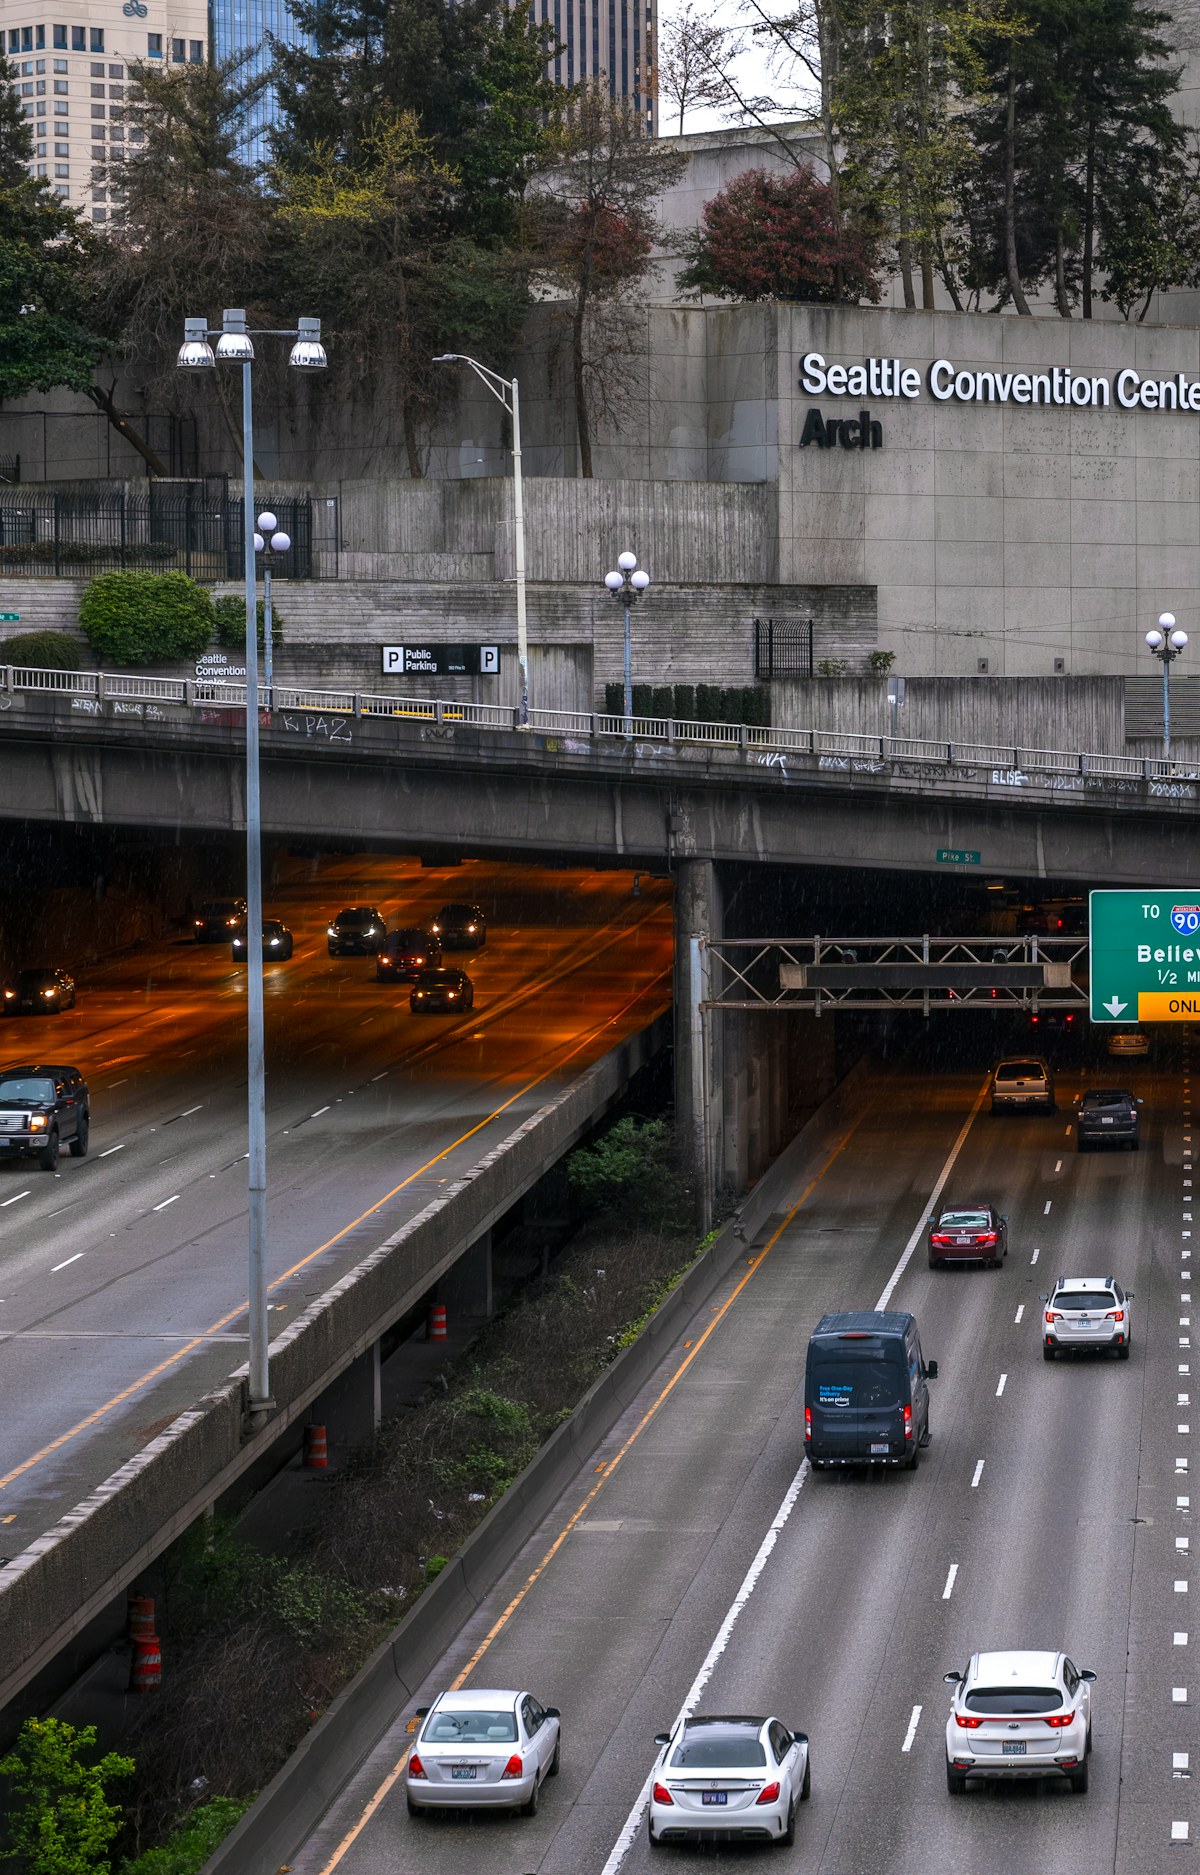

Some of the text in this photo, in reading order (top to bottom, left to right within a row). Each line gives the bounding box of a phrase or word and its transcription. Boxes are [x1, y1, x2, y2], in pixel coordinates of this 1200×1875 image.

[801, 352, 921, 399] Seattle
[928, 358, 1109, 408] Convention
[800, 408, 883, 447] Arch
[389, 652, 399, 668] P
[405, 649, 431, 659] Public
[486, 652, 494, 667] P
[195, 665, 246, 676] Convention
[405, 660, 437, 672] Parking
[942, 852, 960, 861] Pike
[1142, 904, 1160, 919] TO
[1174, 914, 1199, 930] 90
